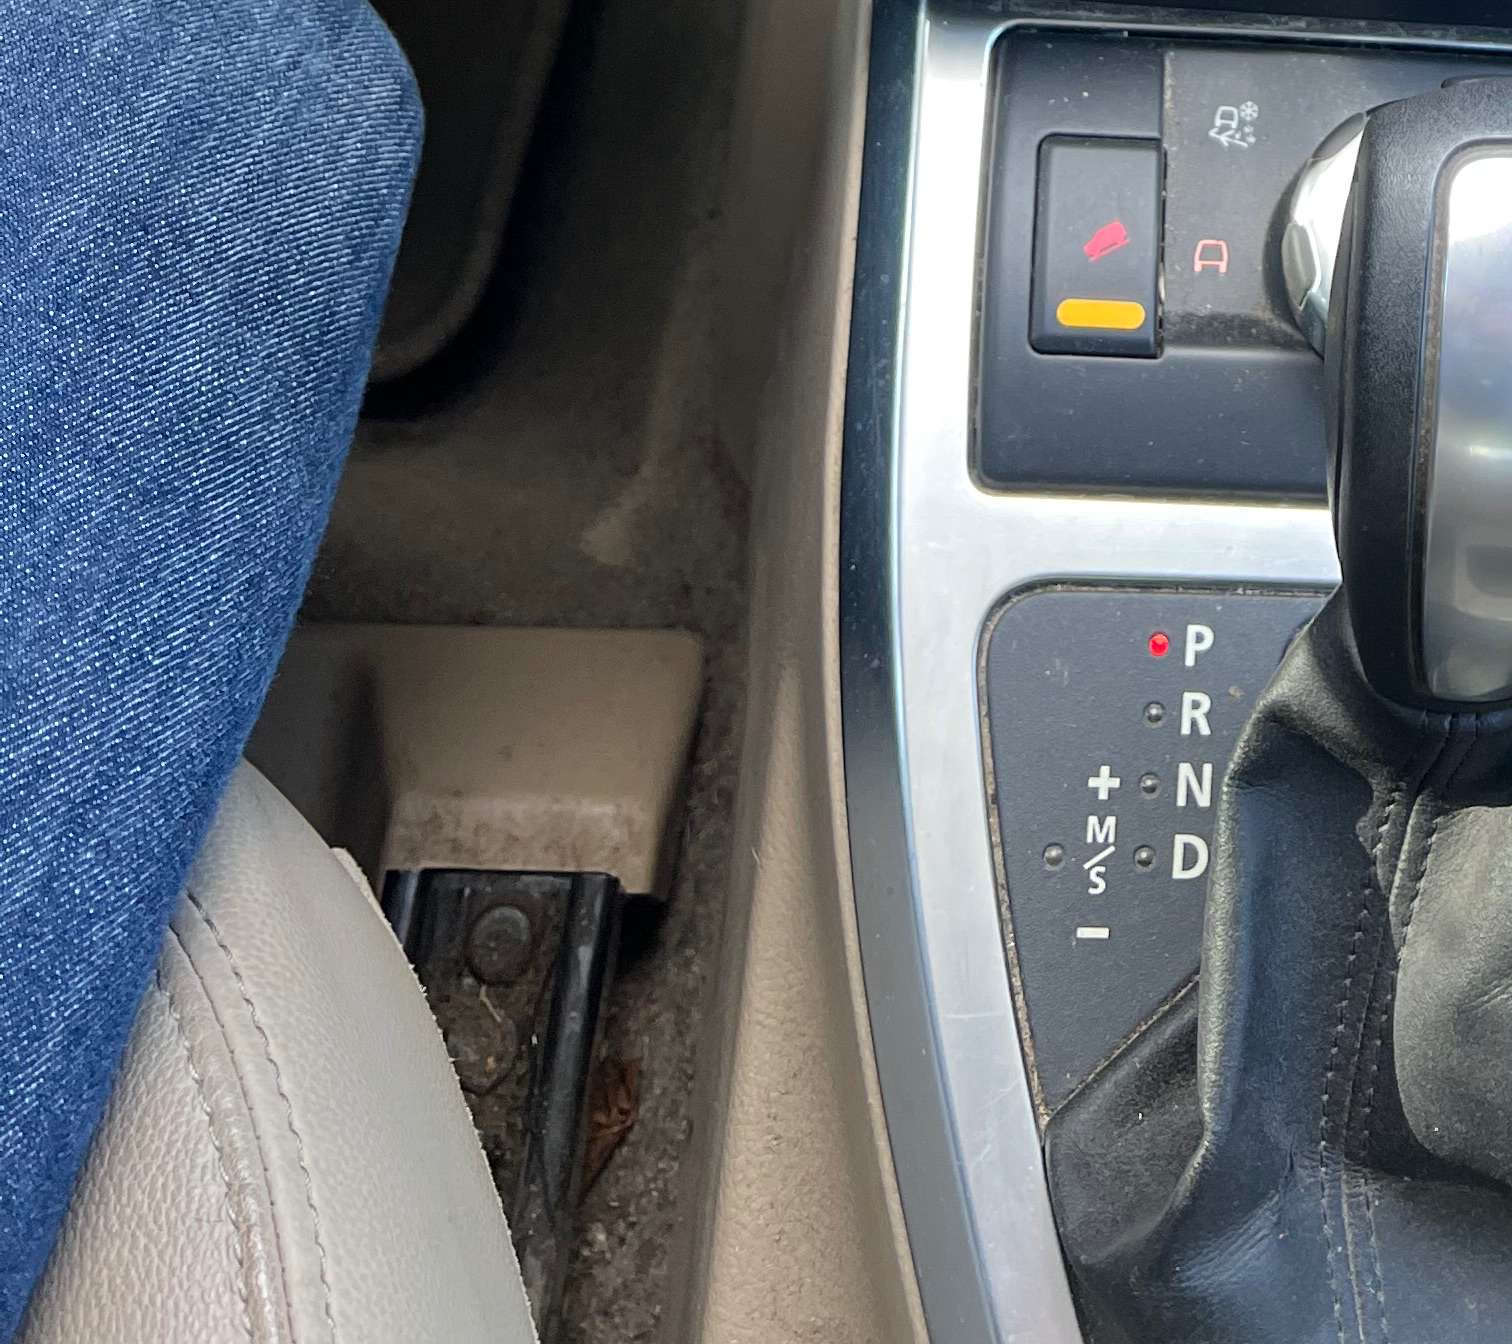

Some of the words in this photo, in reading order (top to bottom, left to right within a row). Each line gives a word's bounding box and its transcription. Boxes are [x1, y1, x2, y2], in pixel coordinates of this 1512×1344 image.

[1184, 624, 1214, 667] P
[1180, 691, 1212, 736] R
[1175, 762, 1213, 808] N
[1171, 833, 1210, 880] D
